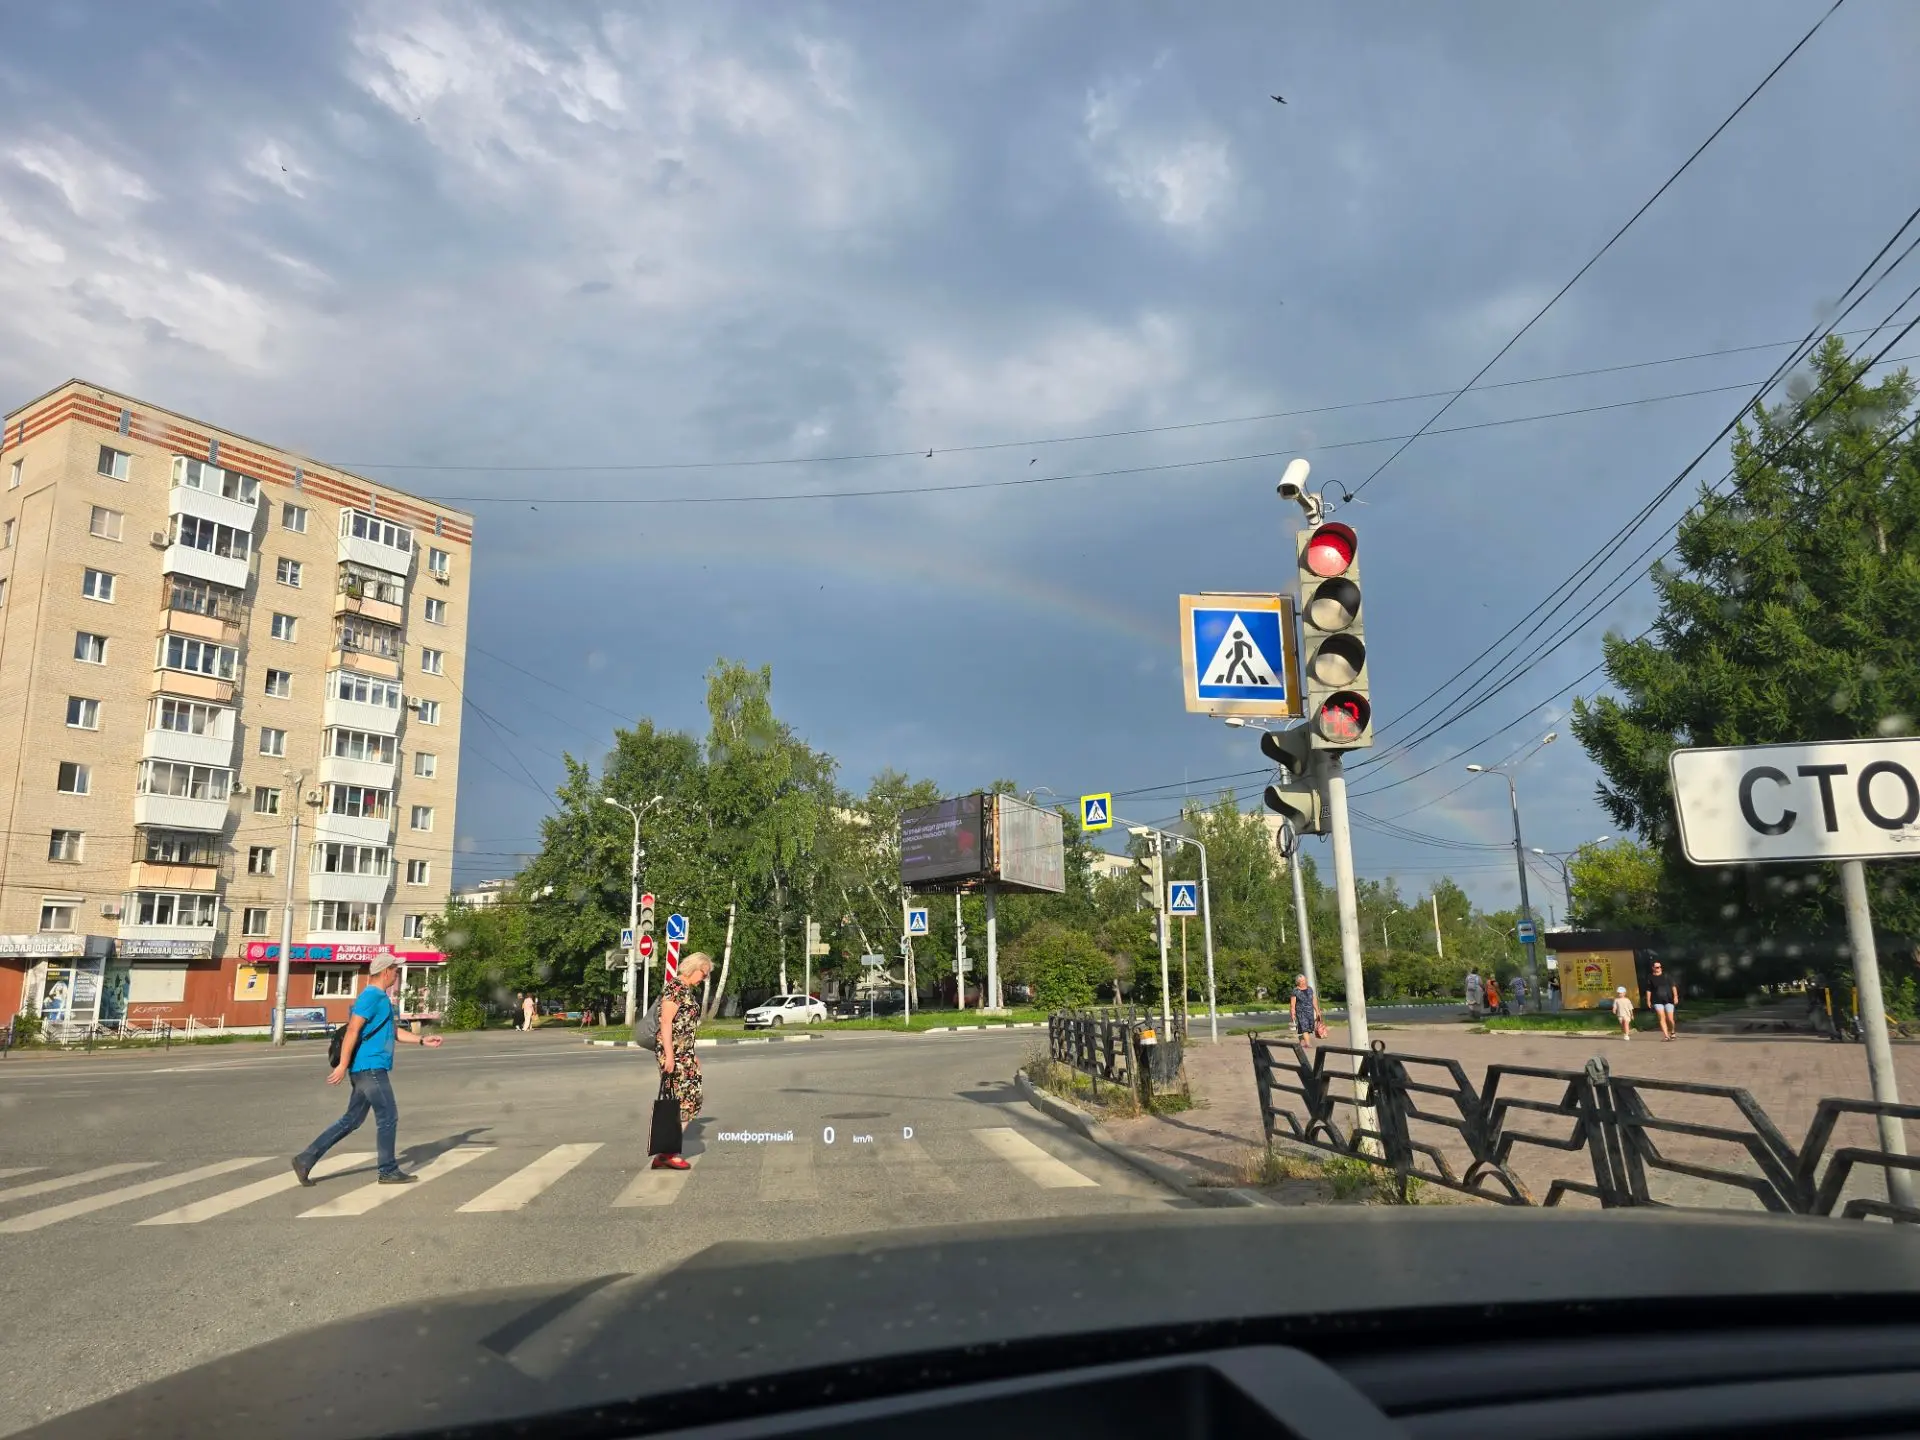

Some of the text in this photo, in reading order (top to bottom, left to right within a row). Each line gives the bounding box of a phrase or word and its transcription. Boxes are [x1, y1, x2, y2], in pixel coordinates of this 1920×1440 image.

[1738, 760, 1920, 836] СТО
[34, 943, 74, 954] ОДЕЖДА
[337, 945, 390, 953] АЗИАТСКИЕ
[717, 1129, 794, 1143] комфортный
[823, 1126, 835, 1144] 0
[852, 1133, 874, 1144] km/h
[903, 1126, 914, 1139] D
